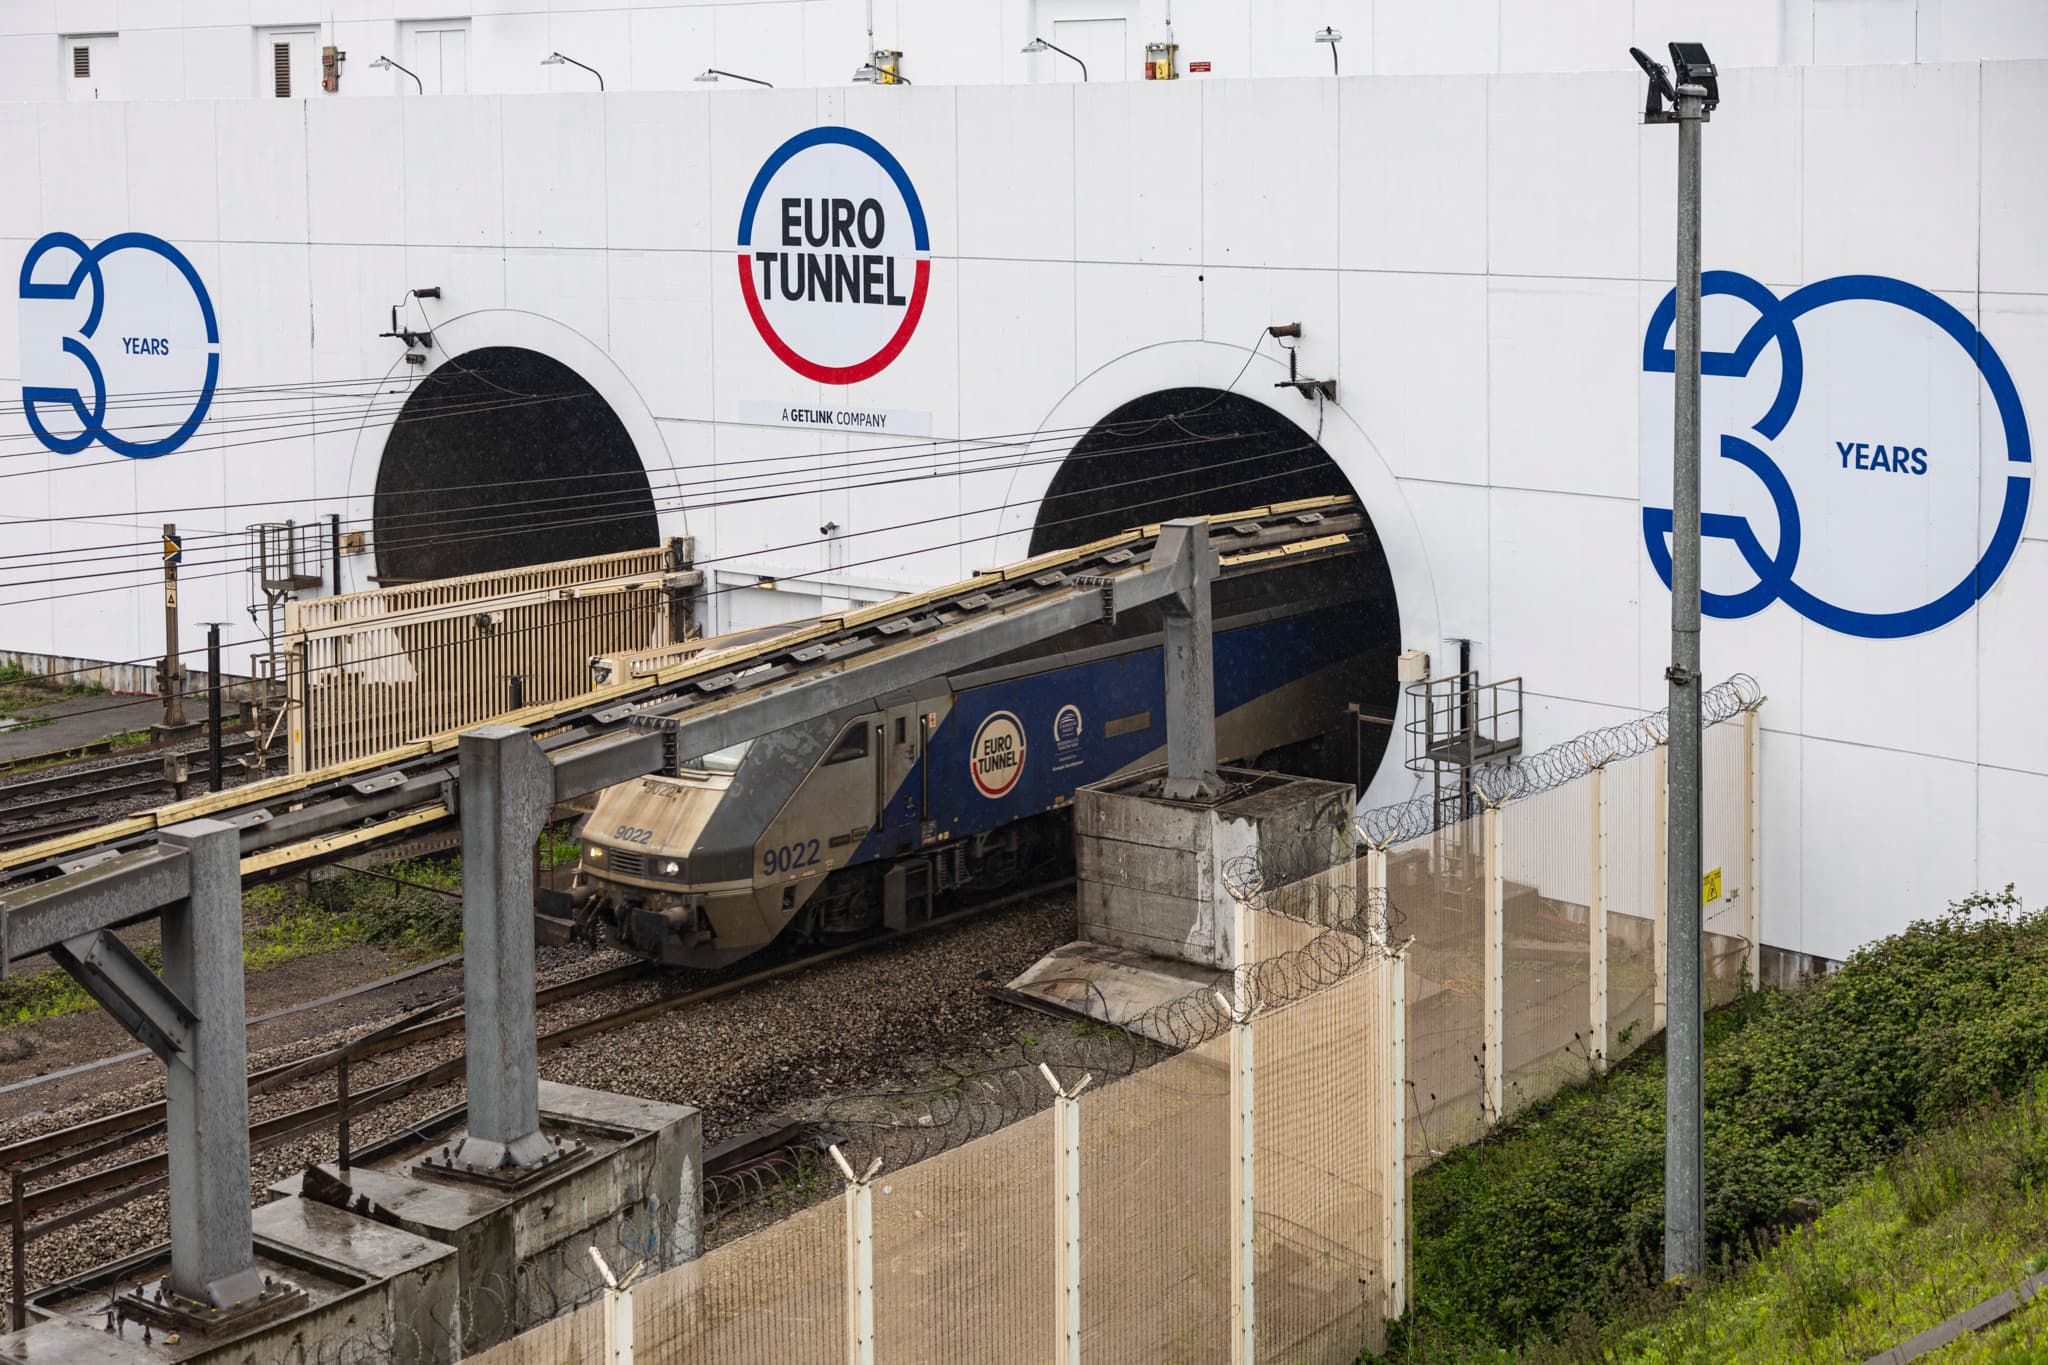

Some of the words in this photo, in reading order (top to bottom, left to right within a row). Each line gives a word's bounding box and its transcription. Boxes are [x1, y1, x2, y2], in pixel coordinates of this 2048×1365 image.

[781, 197, 885, 248] EURO
[756, 252, 906, 307] TUNNEL
[123, 337, 169, 356] YEARS
[782, 408, 789, 422] A
[790, 408, 834, 425] GETLINK
[836, 411, 887, 428] COMPANY
[1836, 441, 1928, 476] YEARS
[984, 734, 1012, 756] EURO
[978, 751, 1017, 775] TUNNEL
[644, 782, 677, 798] 9022
[613, 825, 654, 845] 9022
[763, 838, 820, 877] 9022
